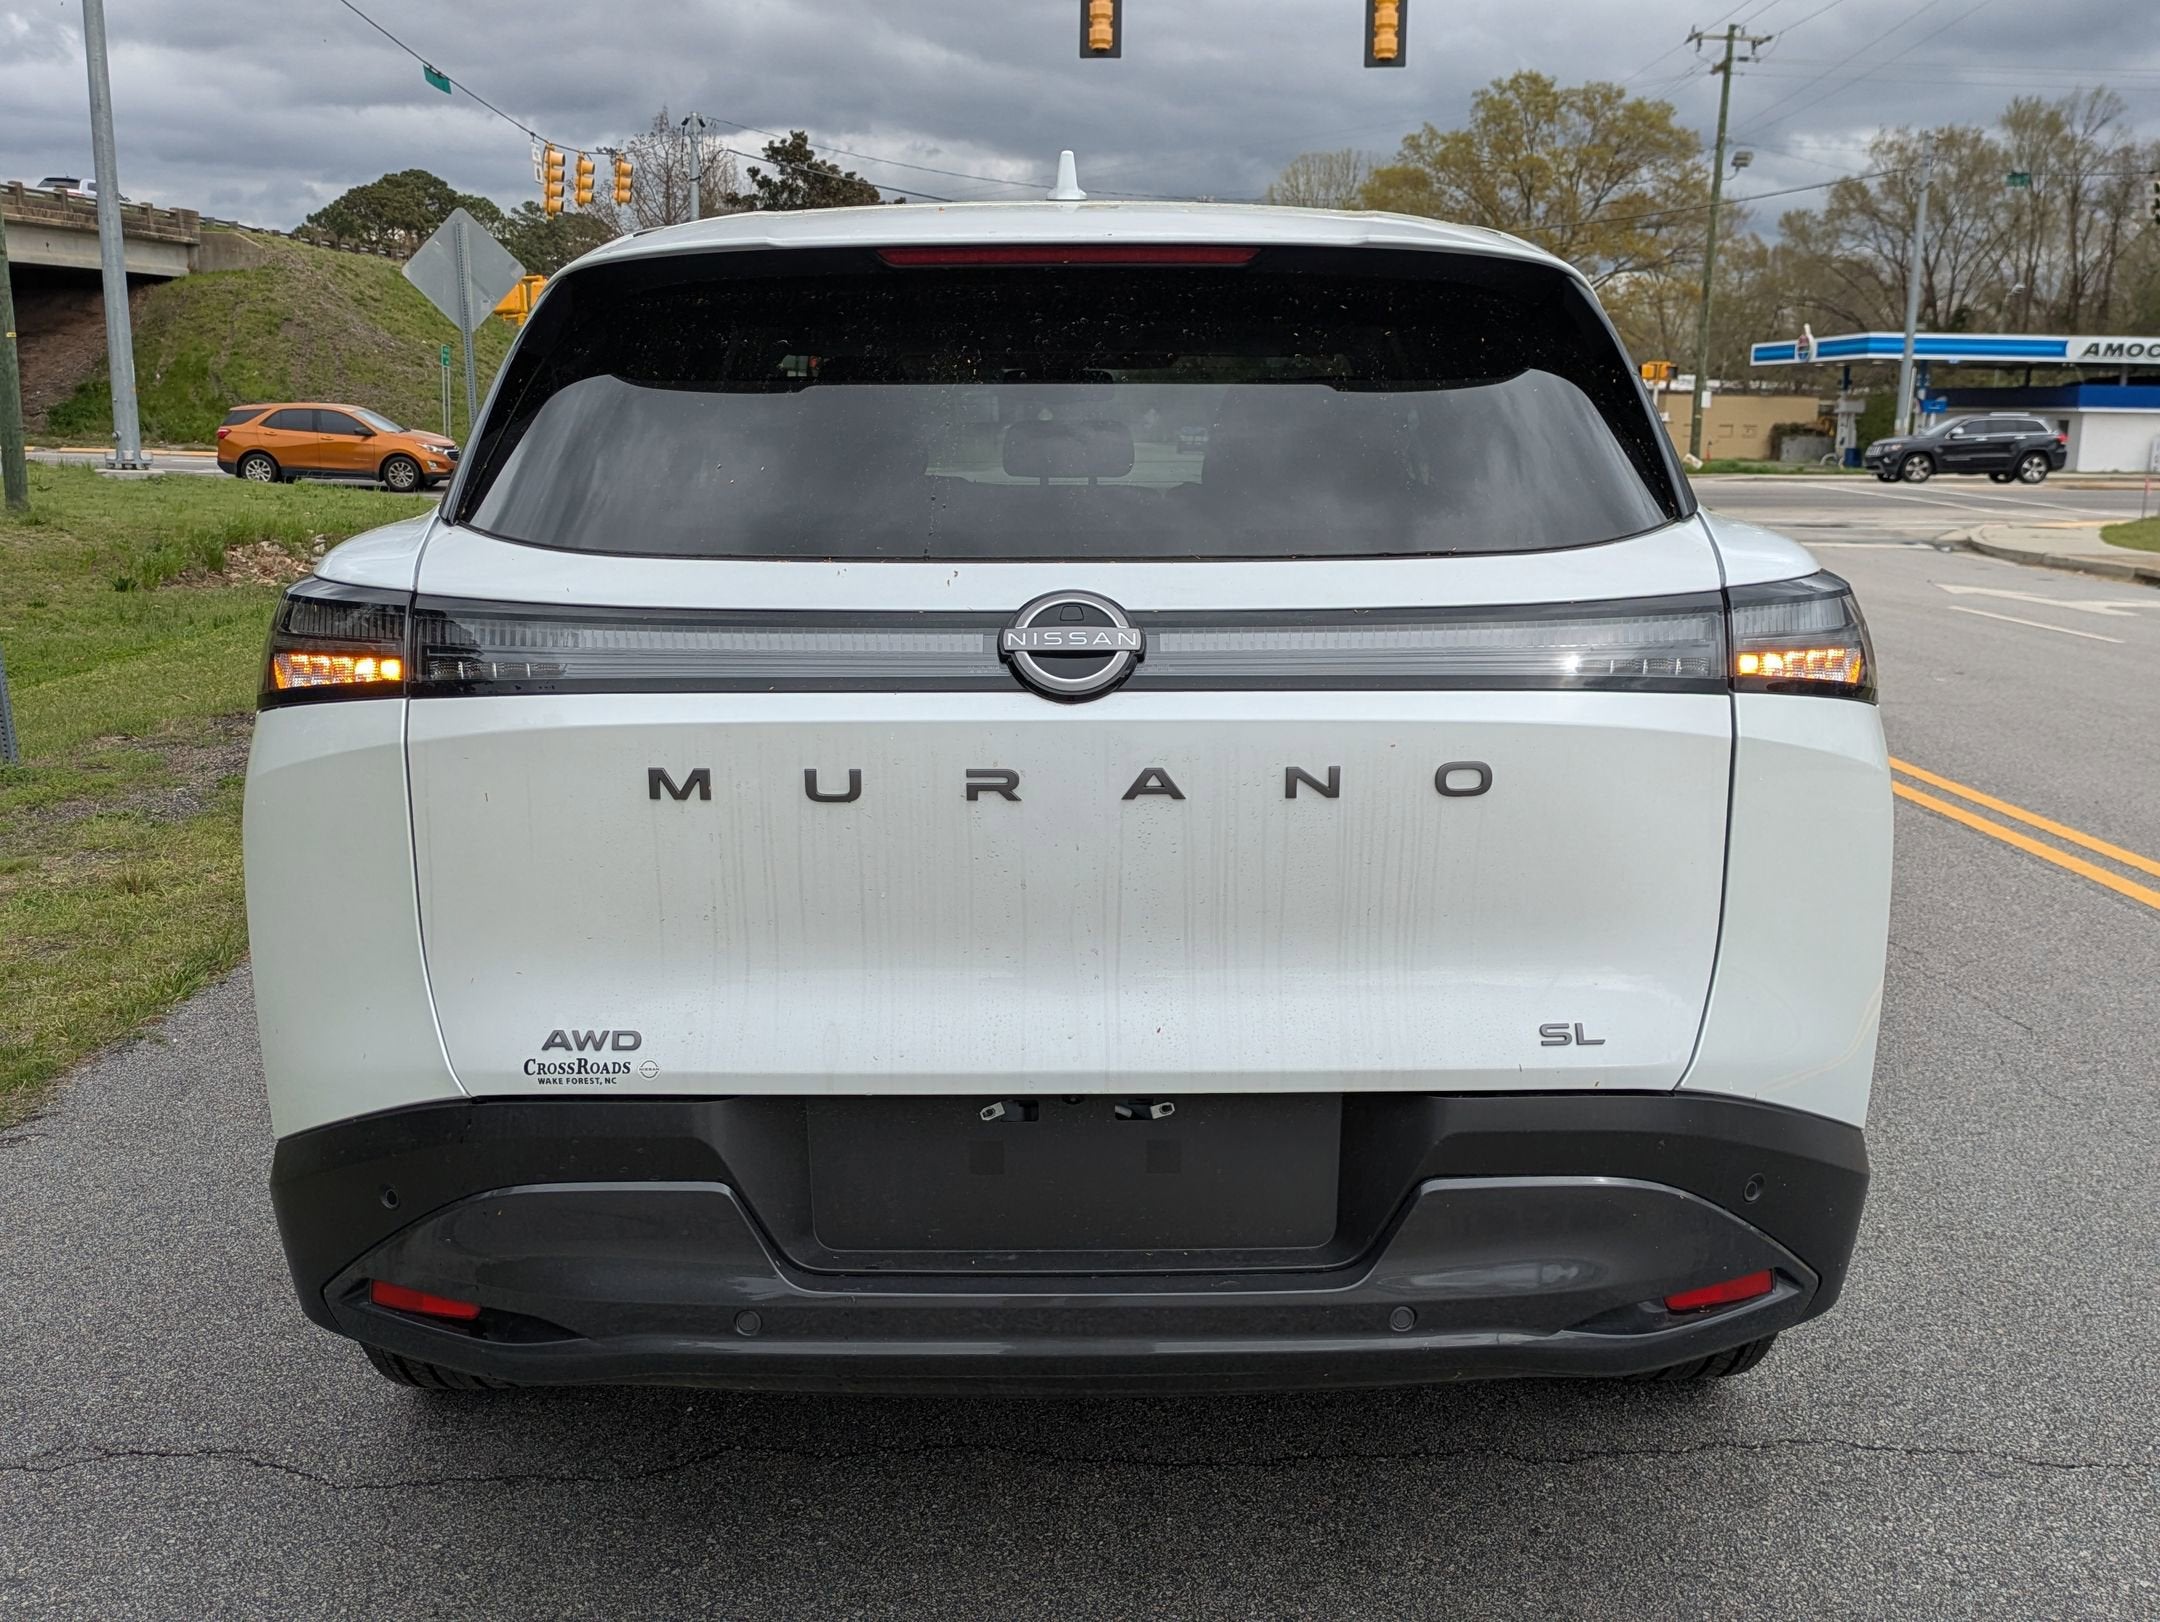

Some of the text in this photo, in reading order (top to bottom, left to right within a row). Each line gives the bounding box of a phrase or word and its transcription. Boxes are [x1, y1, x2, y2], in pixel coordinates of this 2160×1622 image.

[1007, 632, 1136, 646] NISSAN
[648, 761, 1493, 802] MURANO
[541, 1030, 642, 1051] AWD
[1539, 1023, 1606, 1046] SL
[537, 1077, 617, 1086] WAKE FOREST, NC
